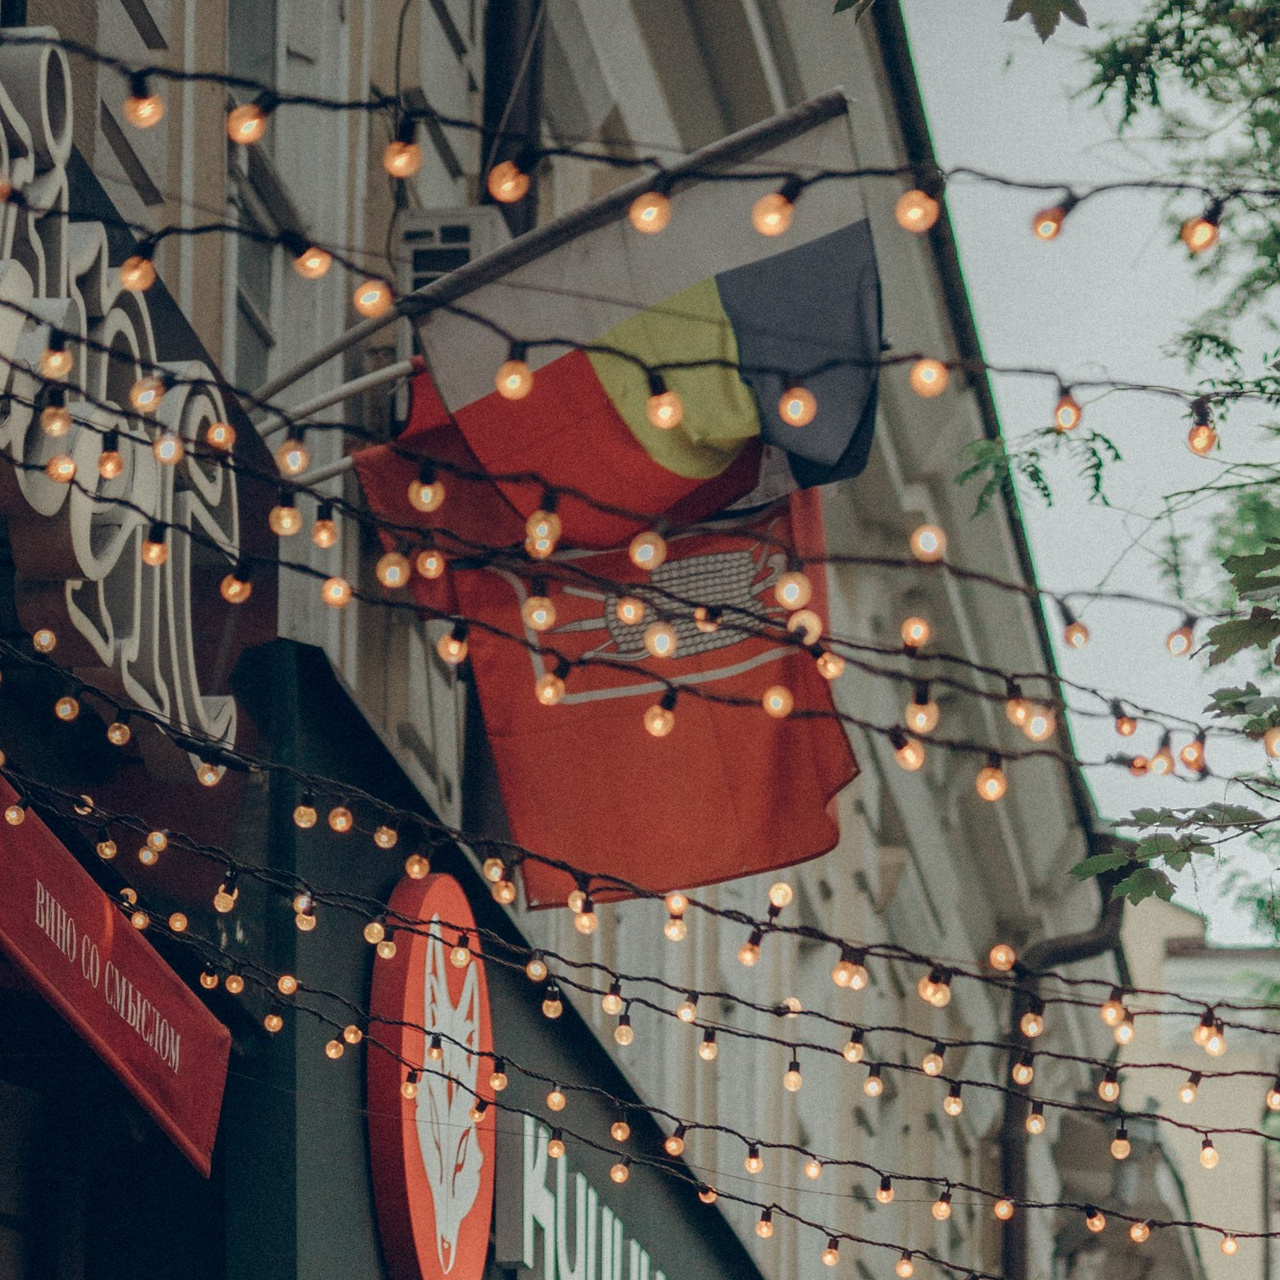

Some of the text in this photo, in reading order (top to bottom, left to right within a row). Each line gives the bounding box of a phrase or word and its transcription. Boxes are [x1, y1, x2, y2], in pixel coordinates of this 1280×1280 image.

[0, 26, 239, 782] ine
[35, 878, 181, 1076] ВИНО СО СМЫСЛОМ
